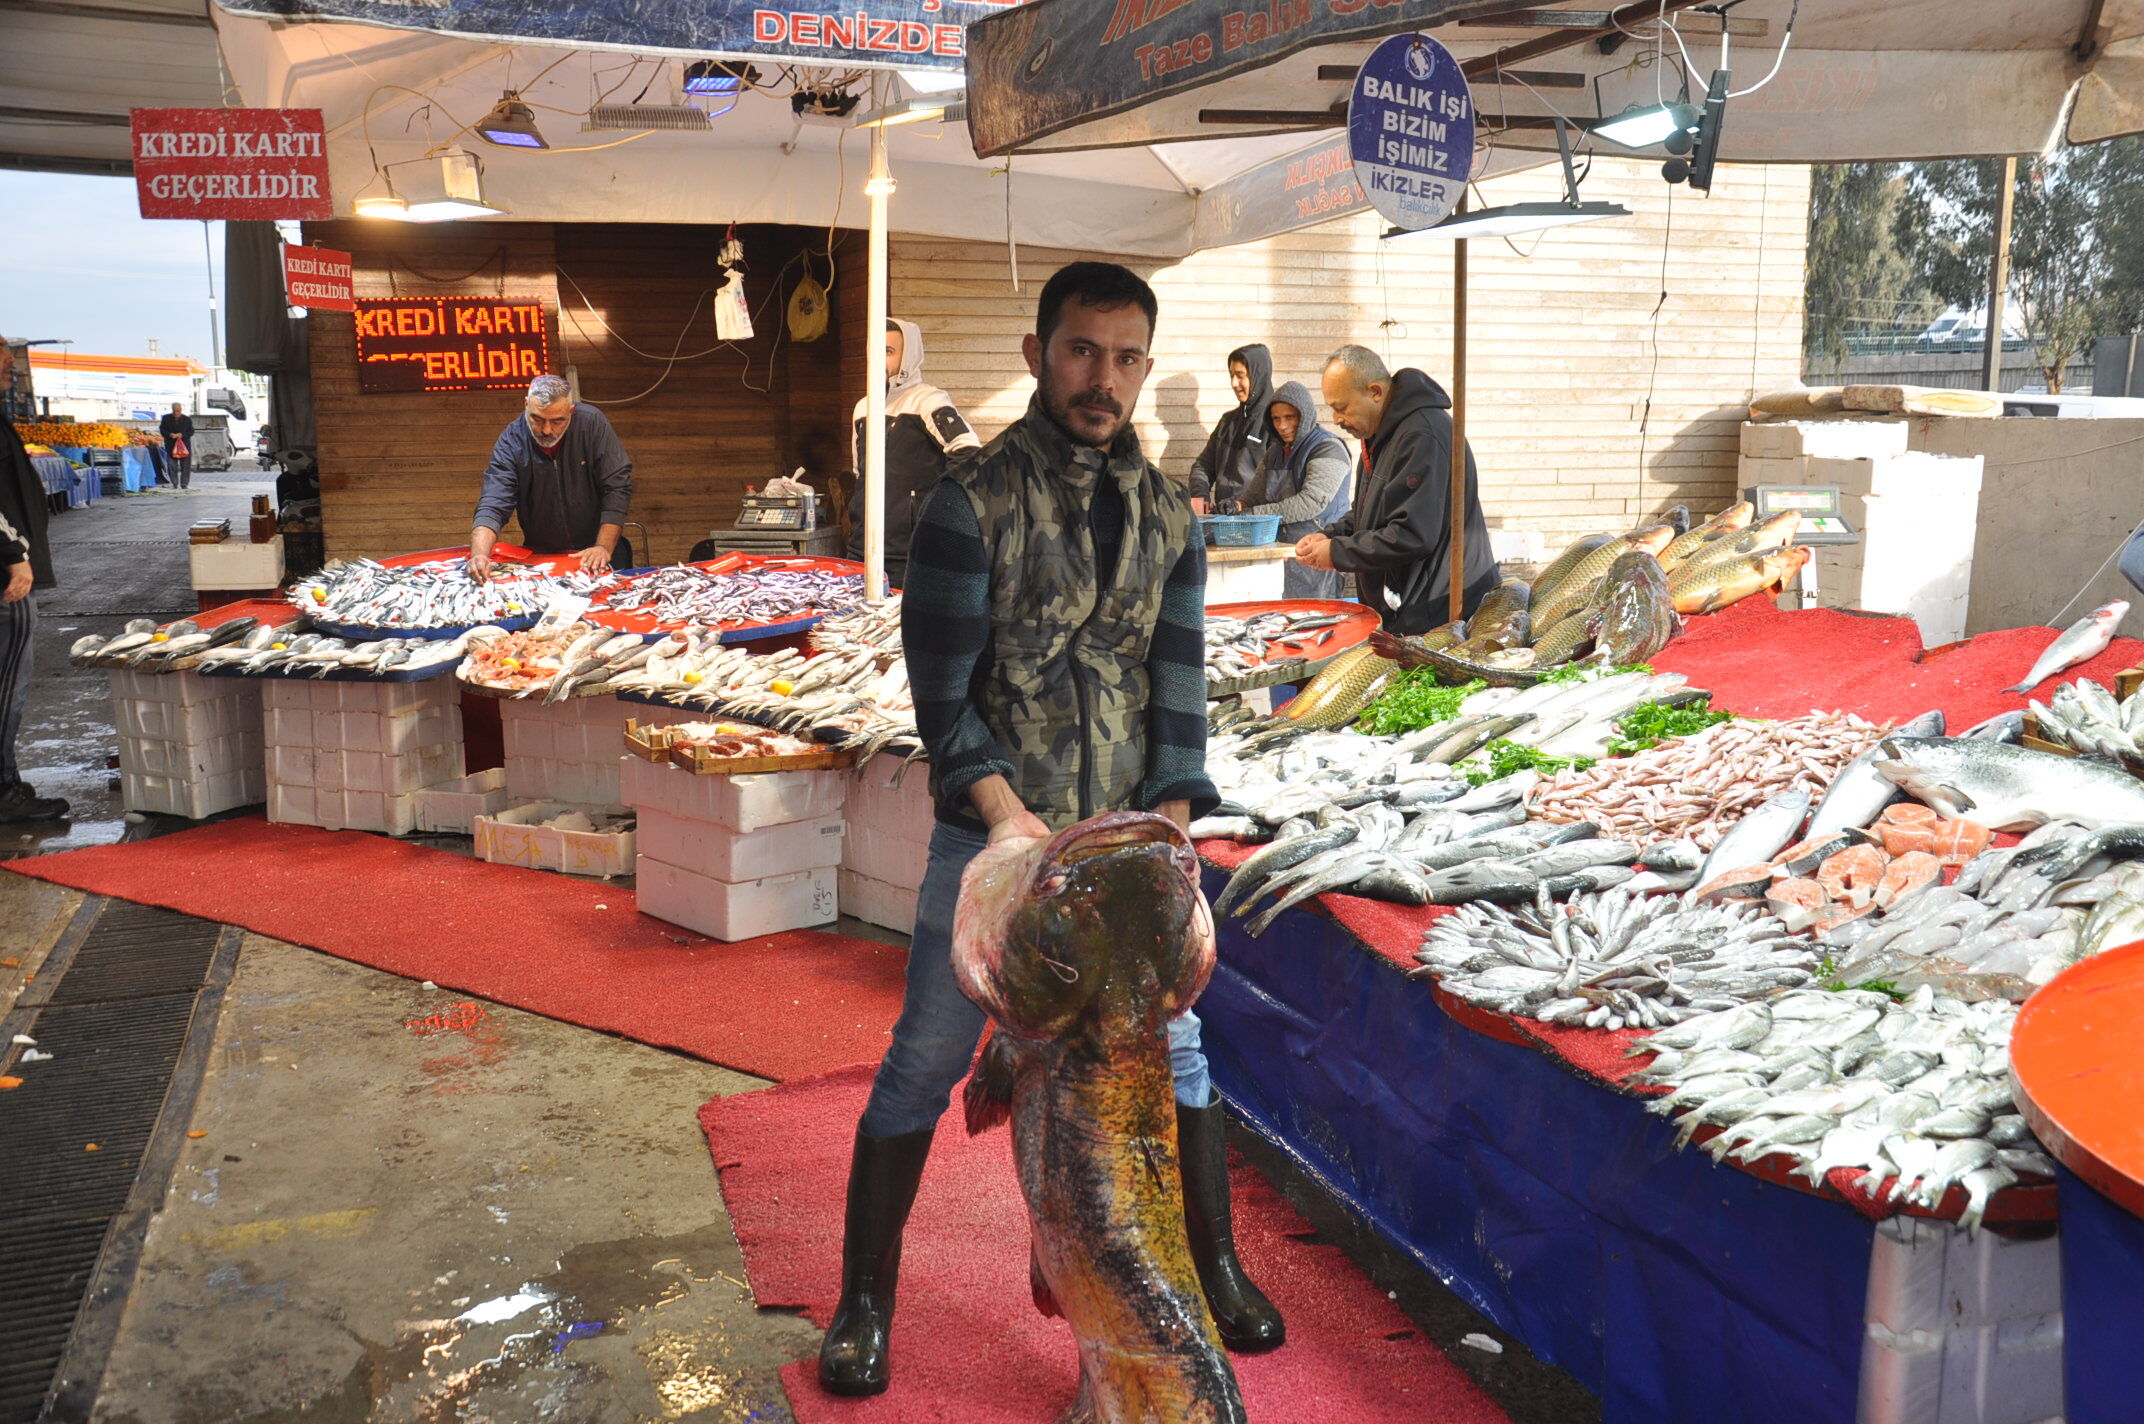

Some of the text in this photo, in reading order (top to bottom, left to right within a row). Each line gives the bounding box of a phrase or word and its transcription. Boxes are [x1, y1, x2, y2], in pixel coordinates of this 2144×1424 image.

[753, 9, 966, 57] DENİZDE
[1134, 33, 1213, 81] Taze
[1363, 75, 1468, 122] BALIK İŞİ
[139, 127, 322, 158] KREDİ KARTI
[1383, 109, 1447, 143] BİZİM
[1378, 134, 1449, 172] İŞİMİZ
[151, 169, 320, 205] GEÇERLİDİR
[1370, 166, 1446, 202] İKİZLER
[1399, 199, 1442, 217] balıkçılık
[287, 258, 352, 278] KREDİ KARTI
[291, 282, 351, 300] GEÇERLİDİR
[354, 301, 541, 337] KREDİ KARTI
[367, 342, 542, 379] ERLİDİR
